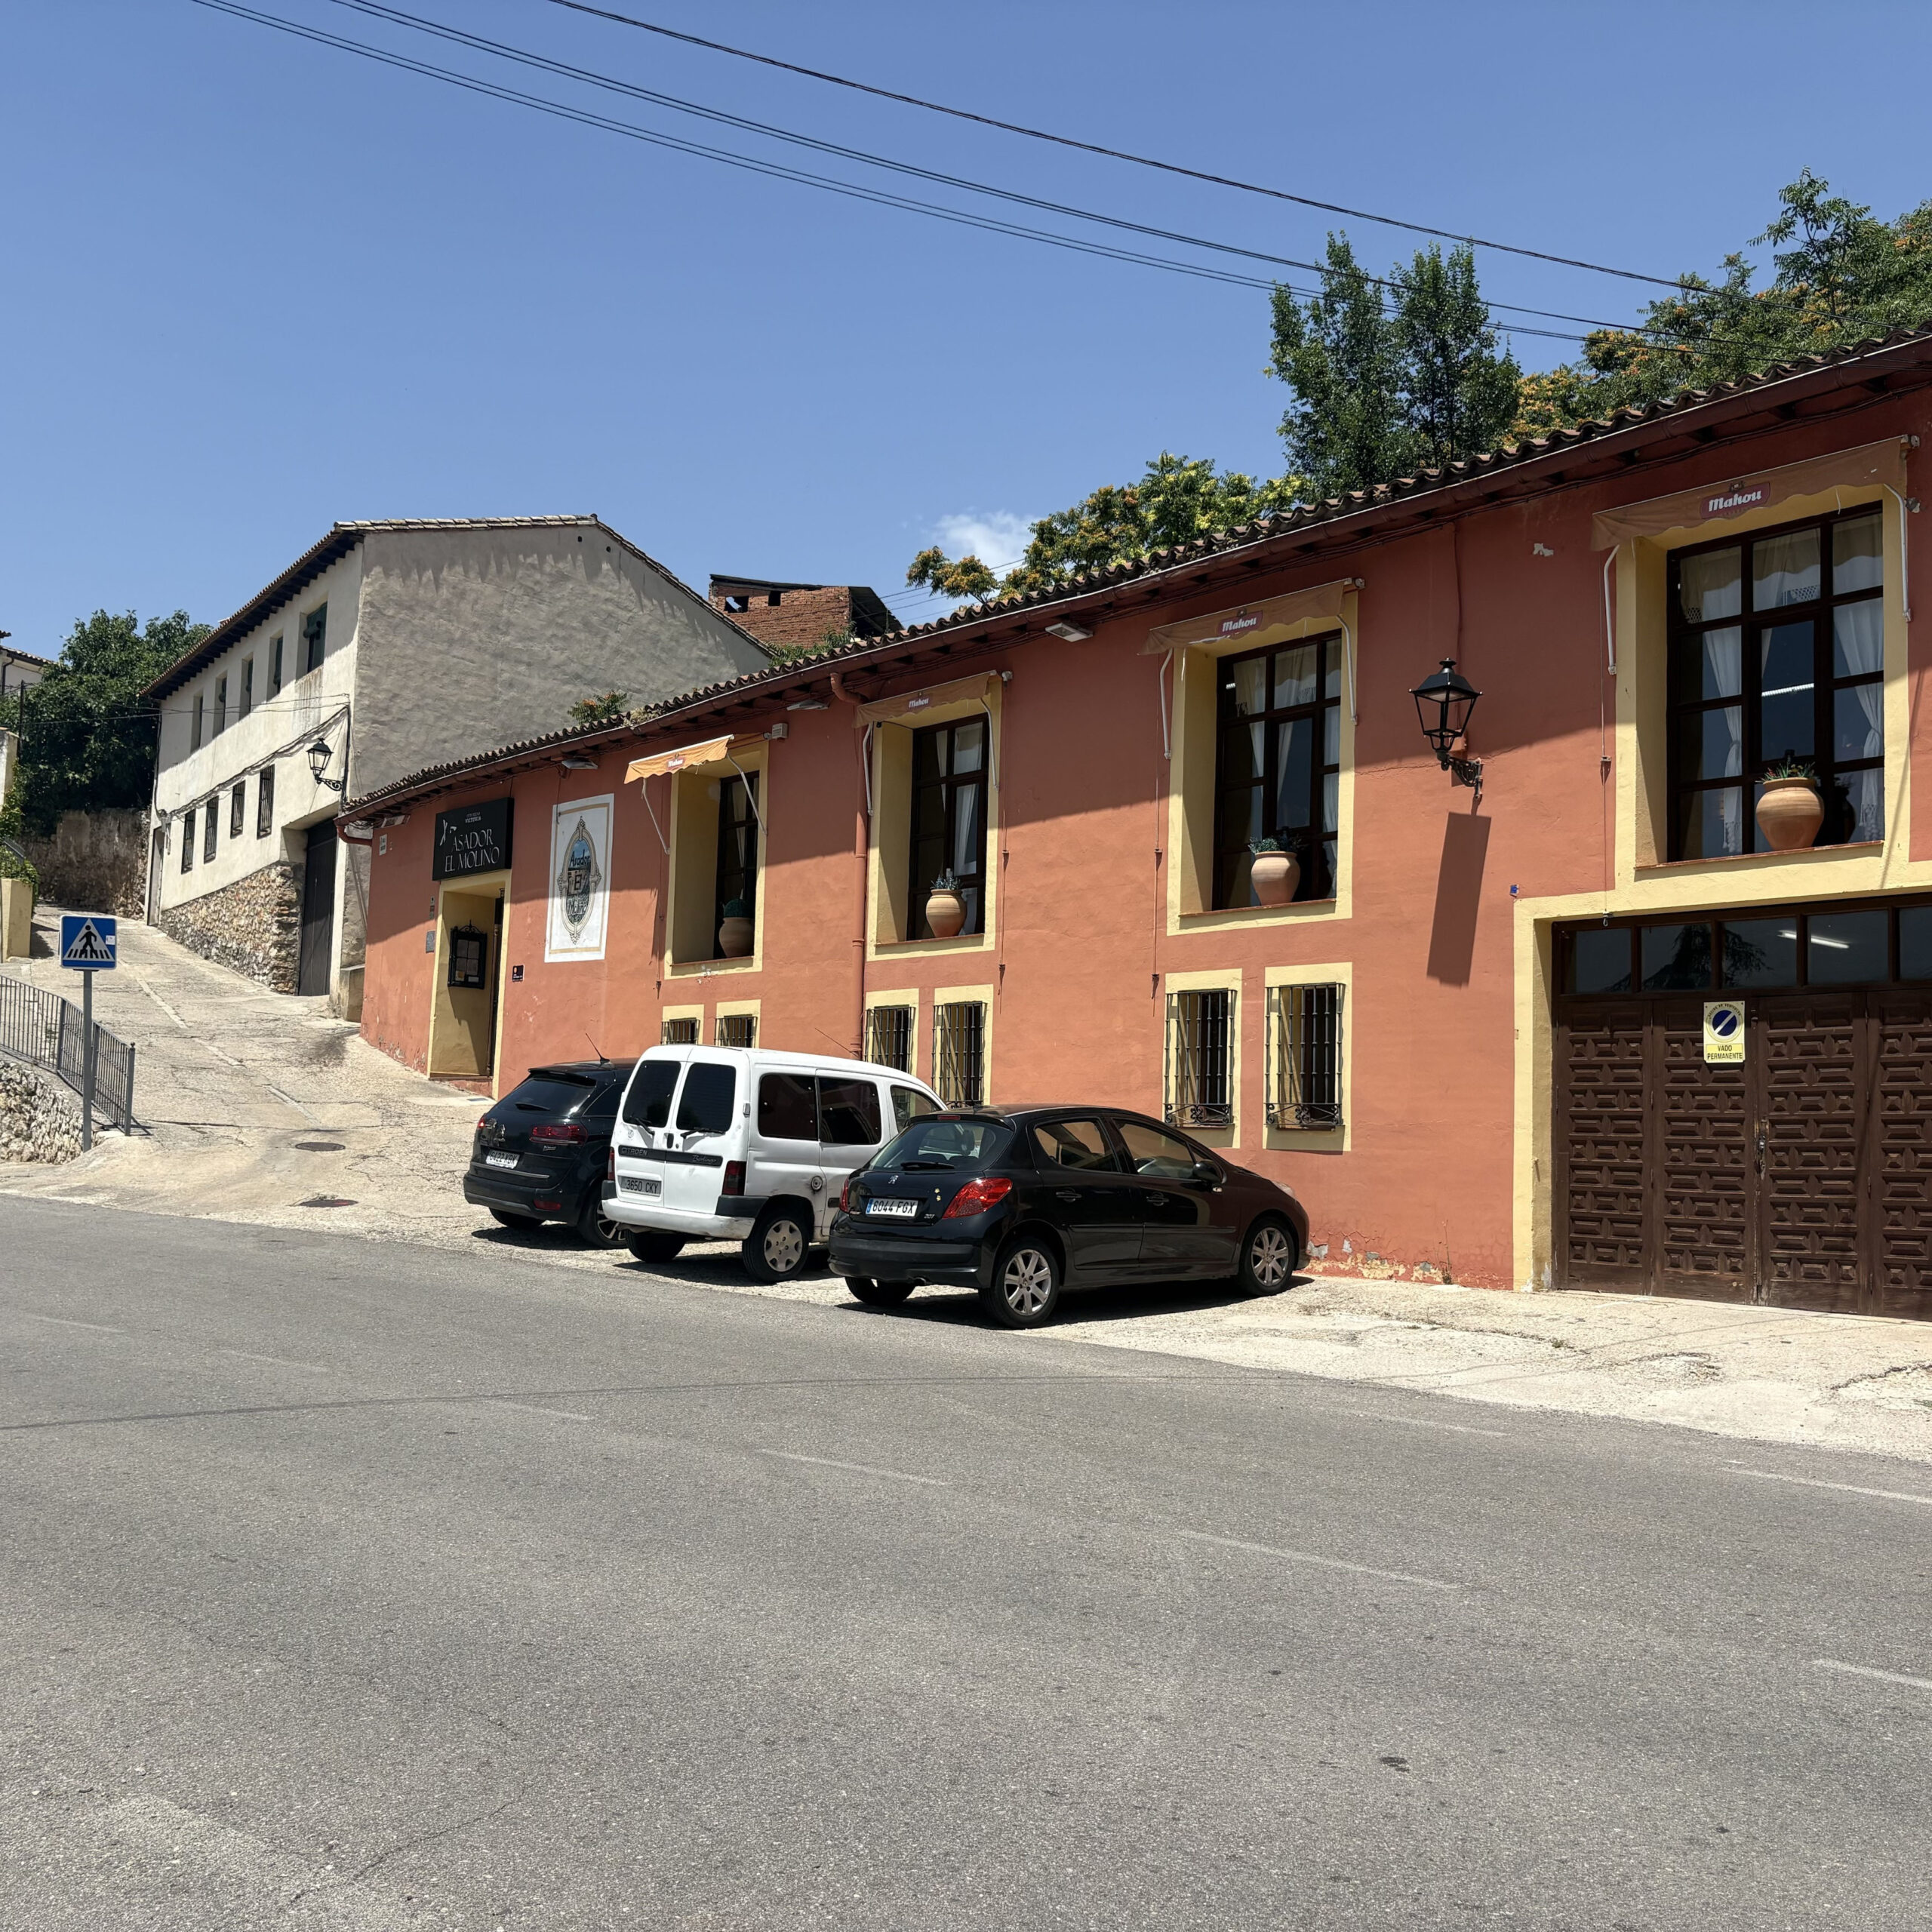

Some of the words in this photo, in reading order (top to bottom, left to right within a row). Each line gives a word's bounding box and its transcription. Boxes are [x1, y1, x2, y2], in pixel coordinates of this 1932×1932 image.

[1708, 491, 1762, 512] Mahou
[1222, 617, 1257, 632] Mahou
[909, 697, 929, 708] Mahou
[453, 829, 494, 851] ASADOR
[445, 855, 456, 872] EL
[457, 847, 500, 869] MOLINO
[569, 849, 591, 867] Asador
[692, 1155, 717, 1166] Berlingo
[626, 1180, 643, 1192] 3650
[645, 1183, 659, 1194] CKY
[872, 1200, 895, 1213] 6044
[895, 1201, 916, 1214] FGX
